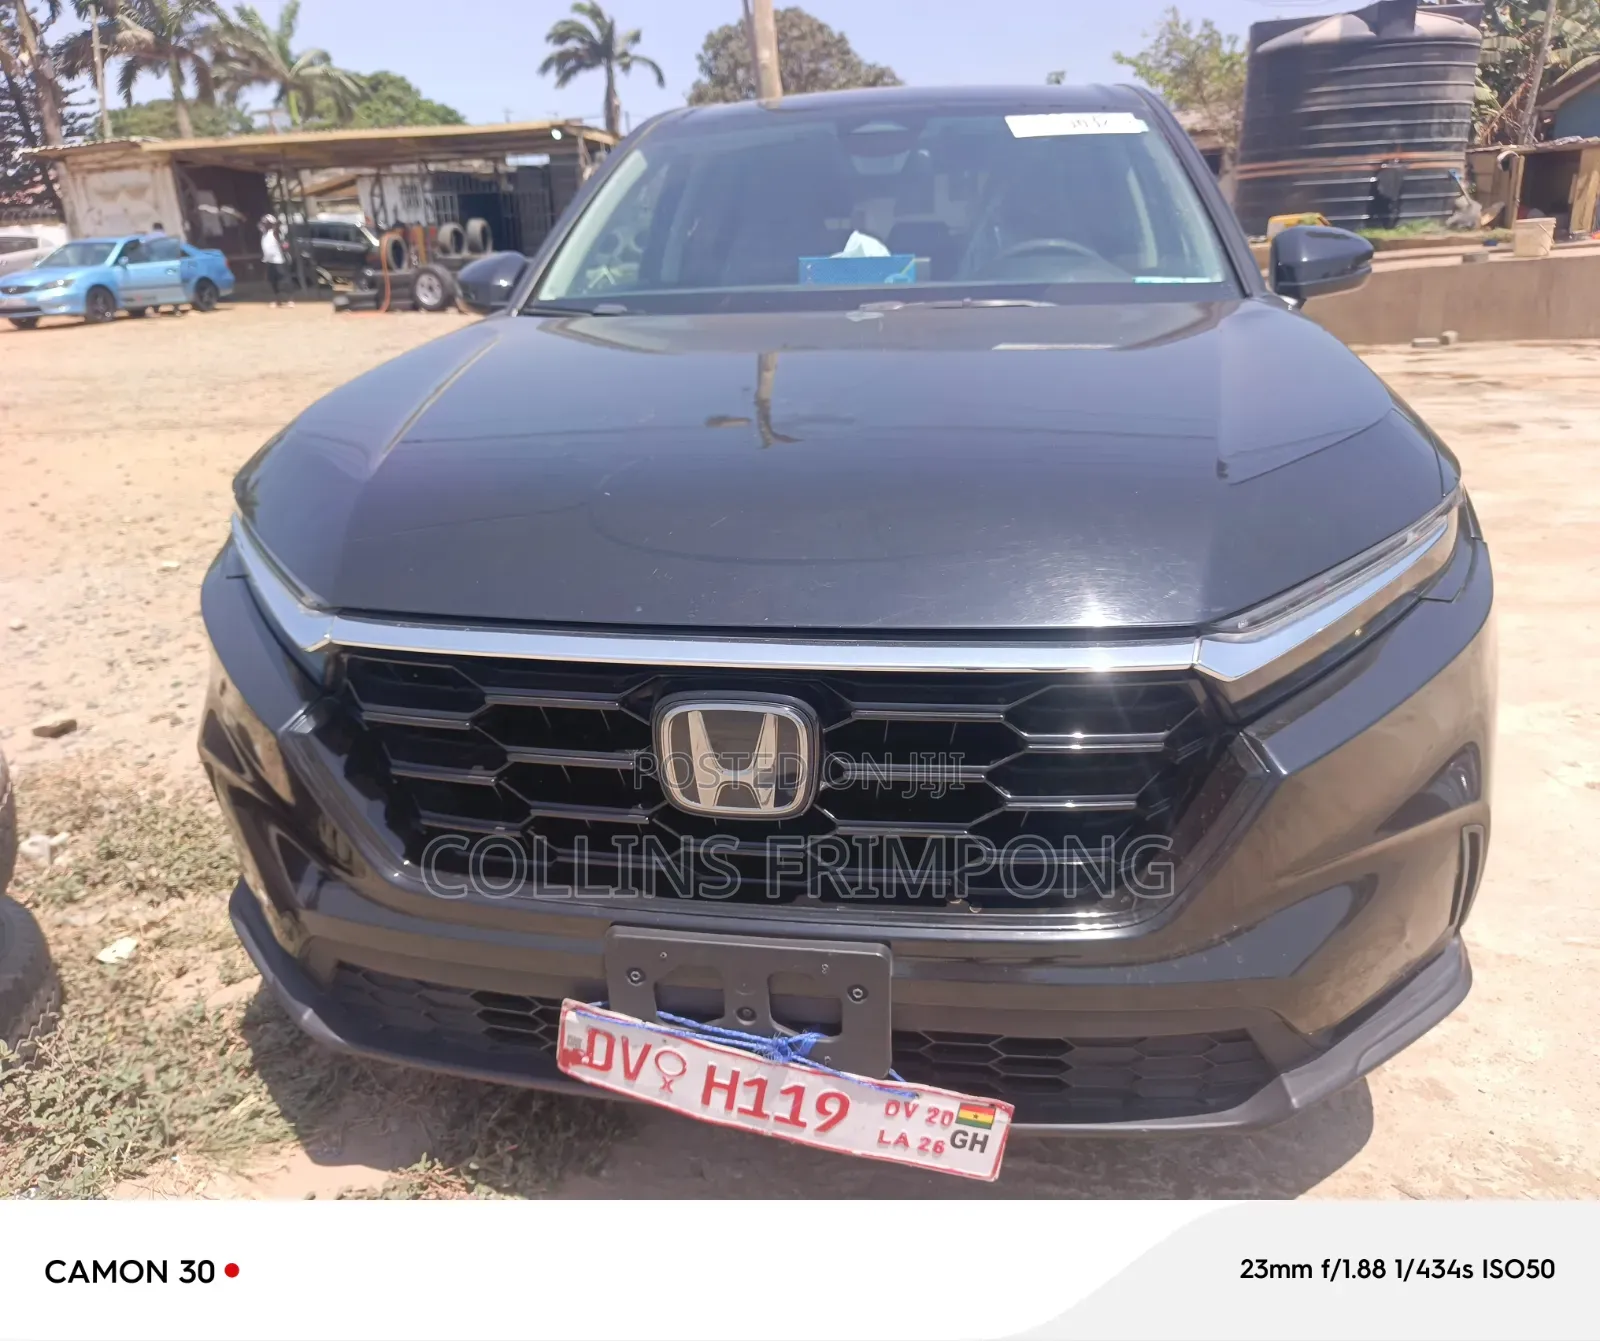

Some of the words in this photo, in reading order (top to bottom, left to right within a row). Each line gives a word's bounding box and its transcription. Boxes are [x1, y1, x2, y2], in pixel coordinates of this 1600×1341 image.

[585, 1026, 653, 1082] DV
[701, 1062, 850, 1133] H119
[884, 1099, 919, 1119] DV
[925, 1106, 955, 1128] 20
[878, 1129, 910, 1149] LA
[918, 1136, 945, 1155] 26
[949, 1129, 989, 1154] GH
